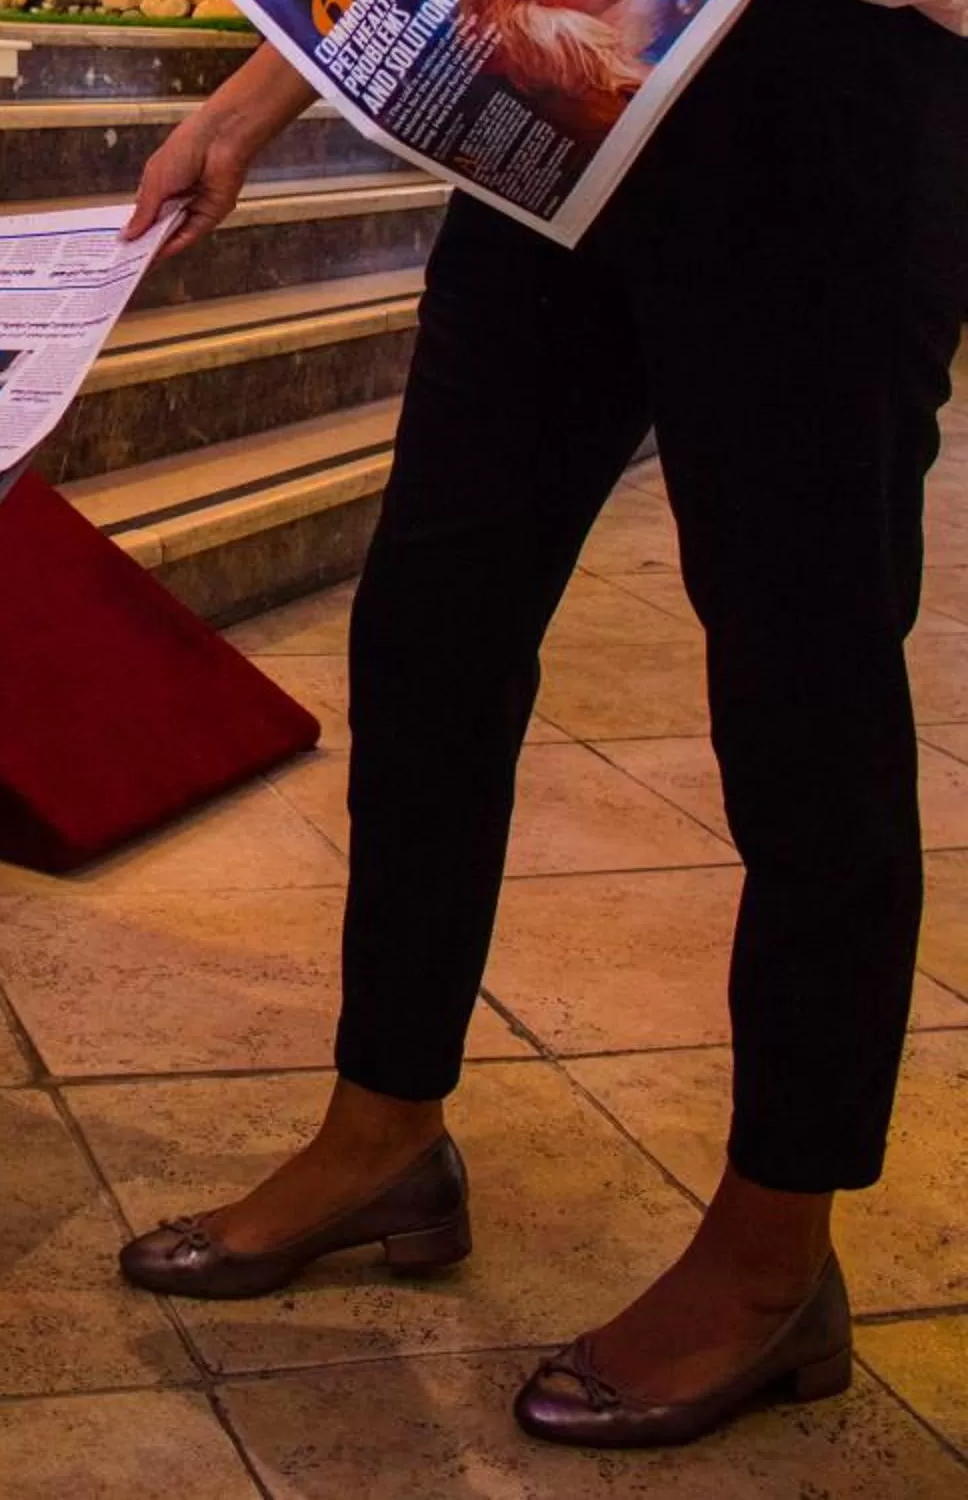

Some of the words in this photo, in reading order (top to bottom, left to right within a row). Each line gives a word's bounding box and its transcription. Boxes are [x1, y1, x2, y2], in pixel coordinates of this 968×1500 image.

[329, 43, 359, 83] PET
[344, 3, 411, 97] PROBLEMS
[361, 68, 398, 115] AND
